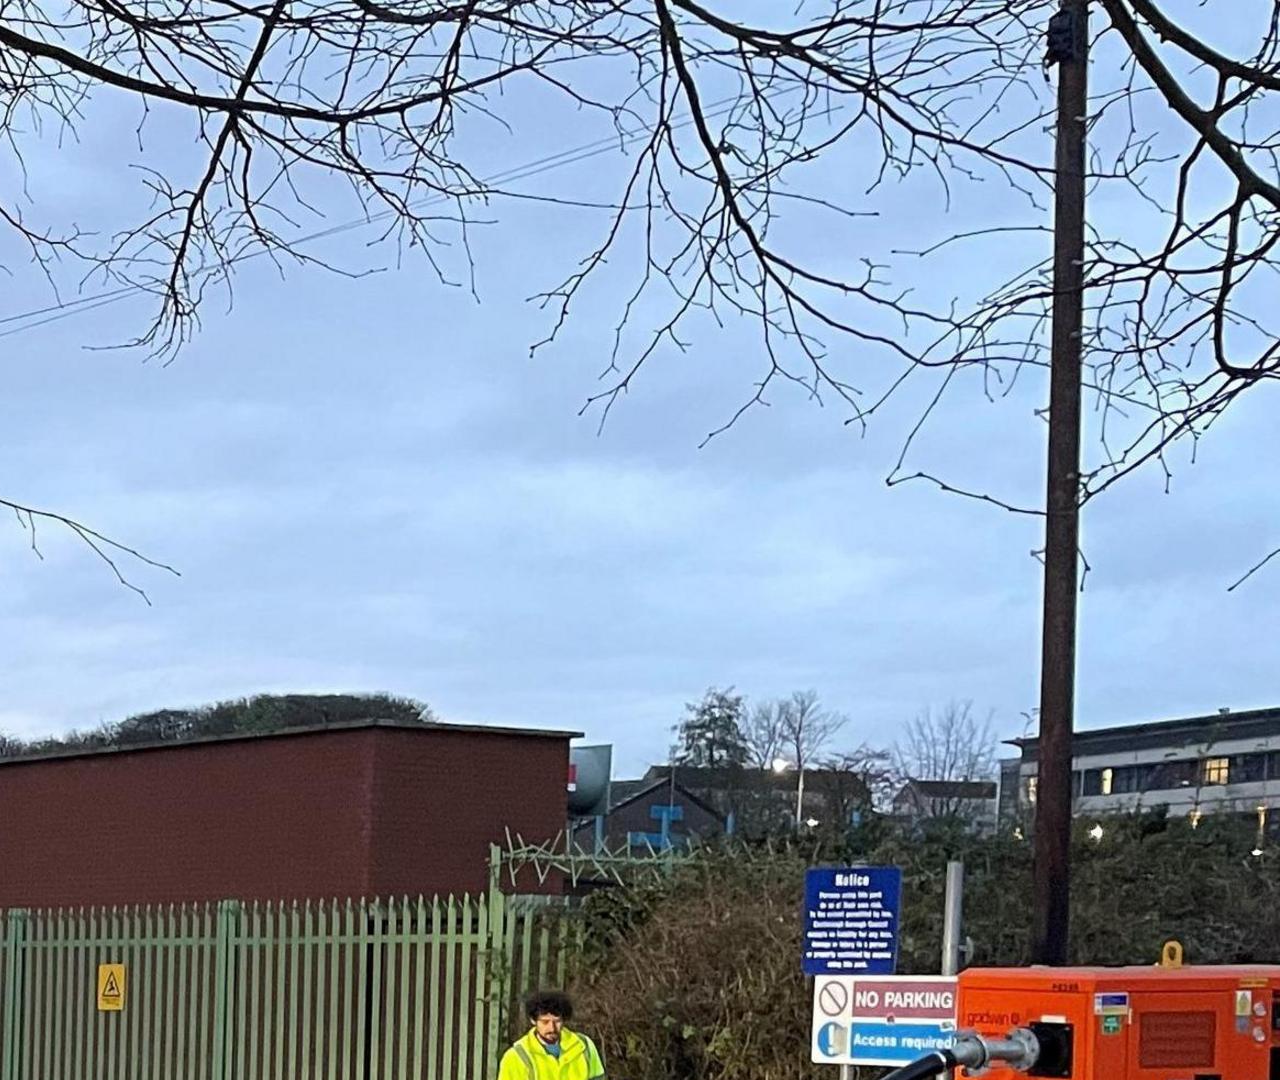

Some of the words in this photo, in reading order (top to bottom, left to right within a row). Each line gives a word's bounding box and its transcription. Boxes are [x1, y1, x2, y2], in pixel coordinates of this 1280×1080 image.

[835, 874, 870, 886] Notice
[855, 991, 879, 1008] NO
[884, 991, 953, 1009] PARKING
[853, 1033, 897, 1048] Access
[901, 1035, 953, 1051] required
